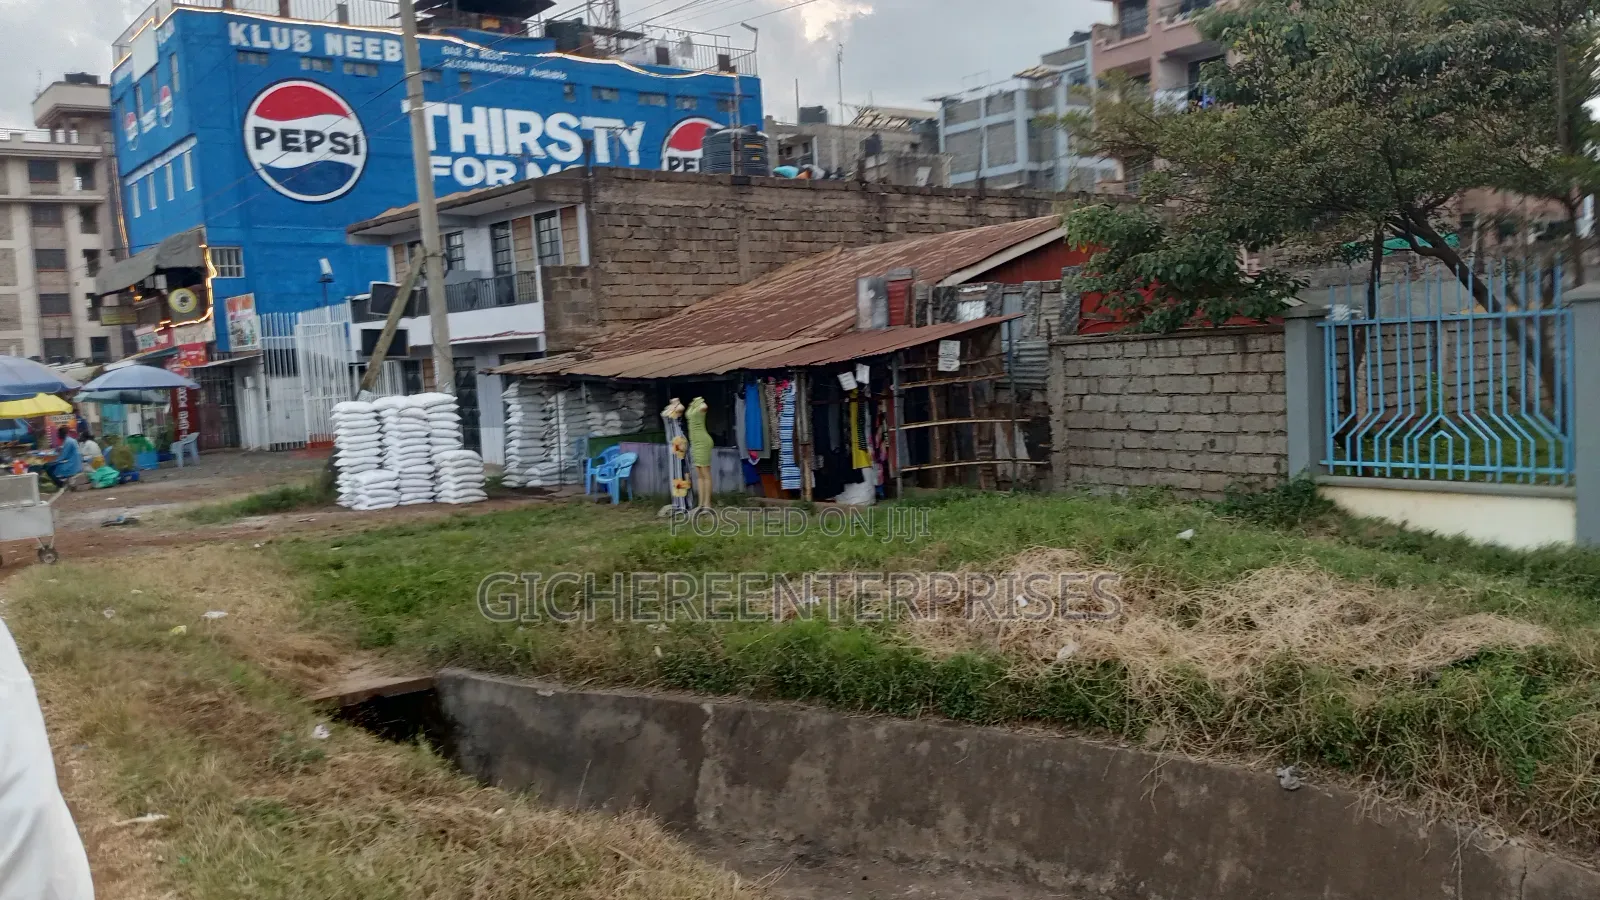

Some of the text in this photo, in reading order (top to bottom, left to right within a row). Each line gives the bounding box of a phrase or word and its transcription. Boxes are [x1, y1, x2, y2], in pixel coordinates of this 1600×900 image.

[228, 22, 420, 62] KLUB NEEB
[442, 59, 526, 75] ACCOMMODATION
[254, 126, 361, 156] PEPSI
[401, 100, 646, 166] THIRSTY
[429, 155, 518, 187] FOR
